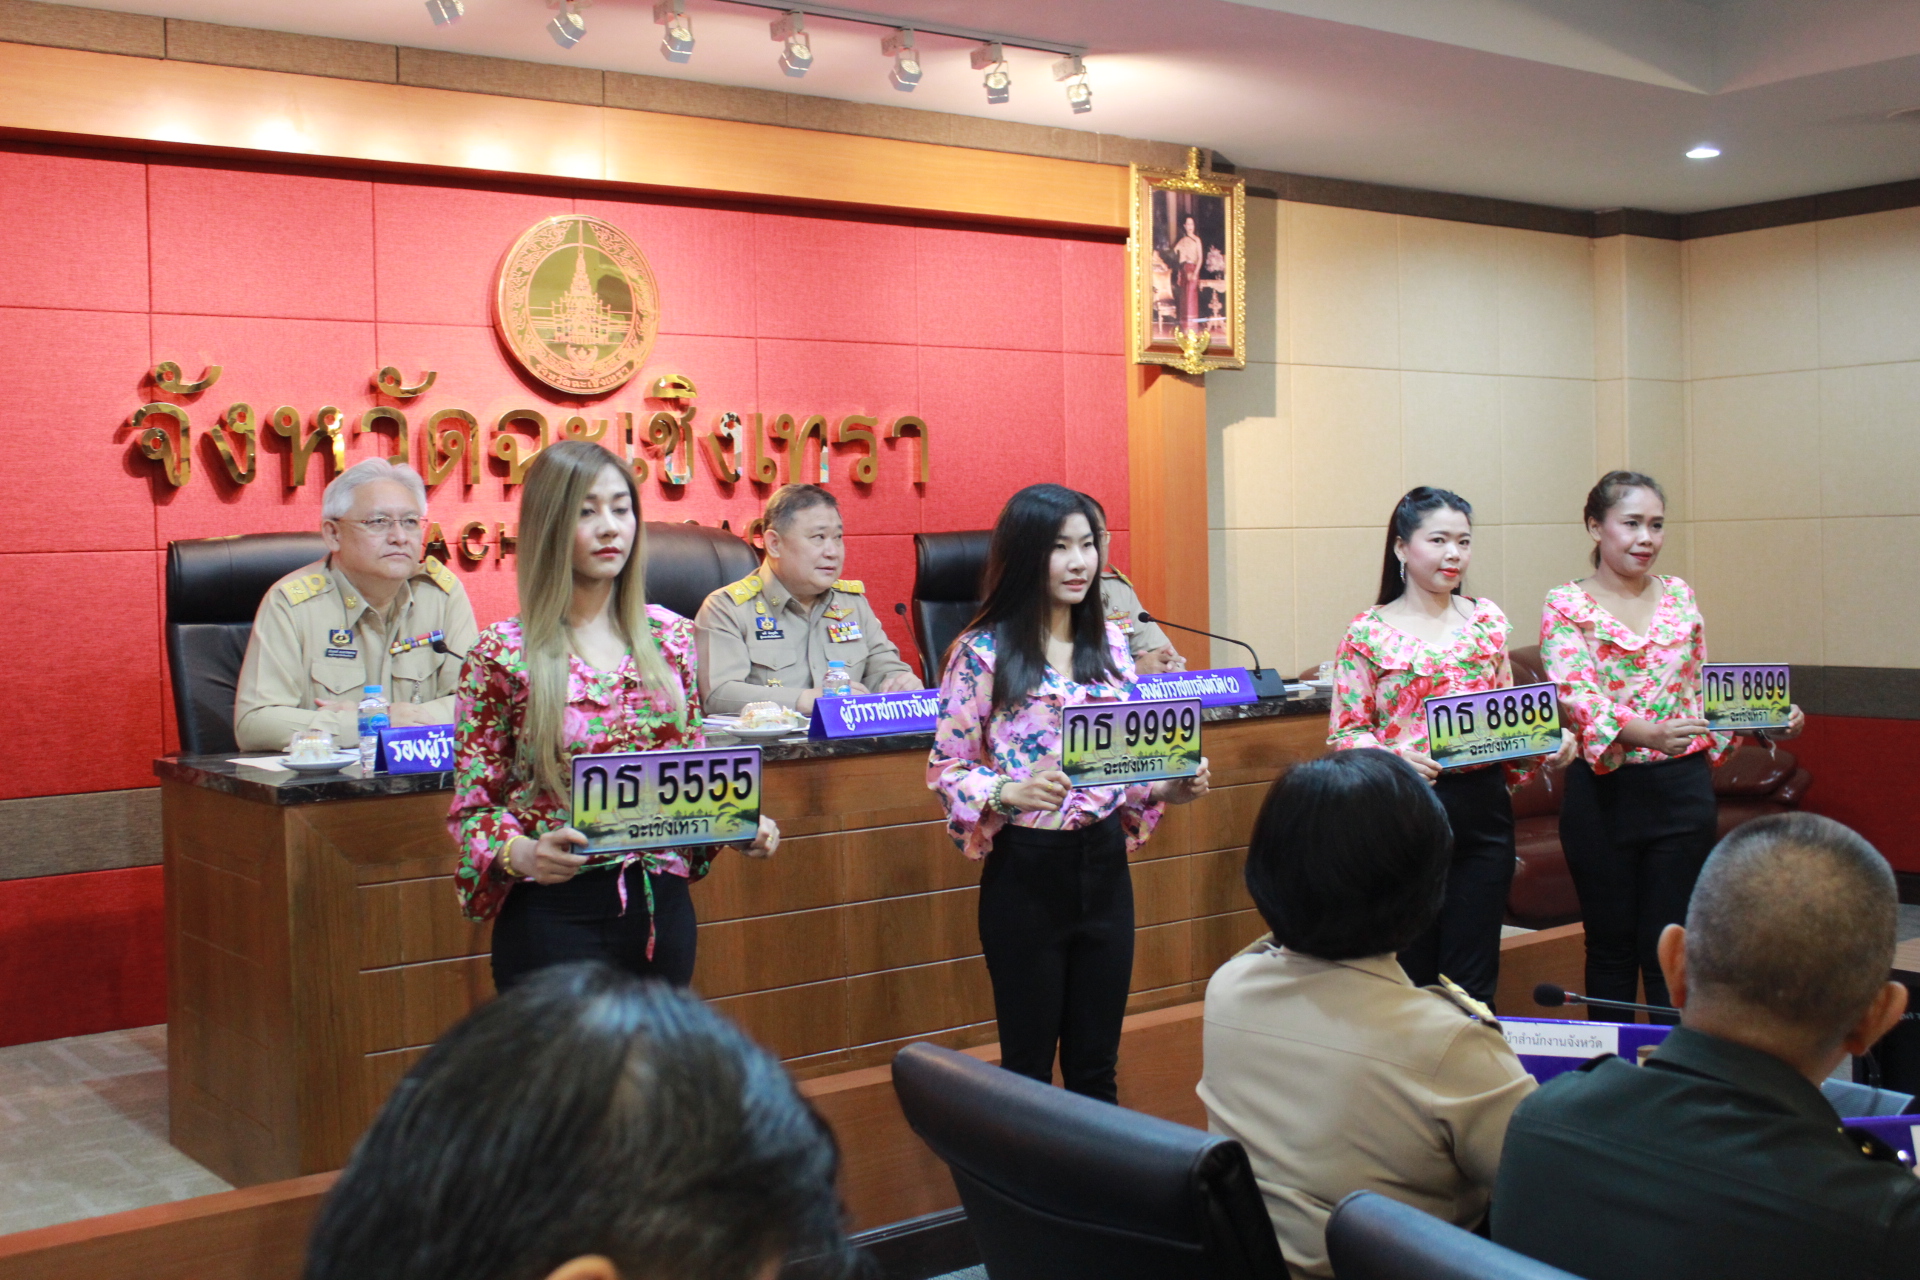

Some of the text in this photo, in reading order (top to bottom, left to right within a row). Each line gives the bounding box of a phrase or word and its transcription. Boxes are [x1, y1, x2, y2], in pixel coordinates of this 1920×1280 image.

[1136, 674, 1240, 700] รองผ้ว่าราชการจังหวัด(2)
[1706, 670, 1786, 702] กธ 8899
[840, 694, 941, 731] ผู้ว่าราชการจังห
[1432, 690, 1553, 739] กธ 8888
[1069, 706, 1195, 753] กธ 9999
[1469, 737, 1527, 756] ฉะเชิงเทรา
[1103, 756, 1163, 775] ฉะเชิงเทรา
[582, 756, 753, 812] กธ 5555
[628, 814, 710, 839] ฉะเชิงเทรา
